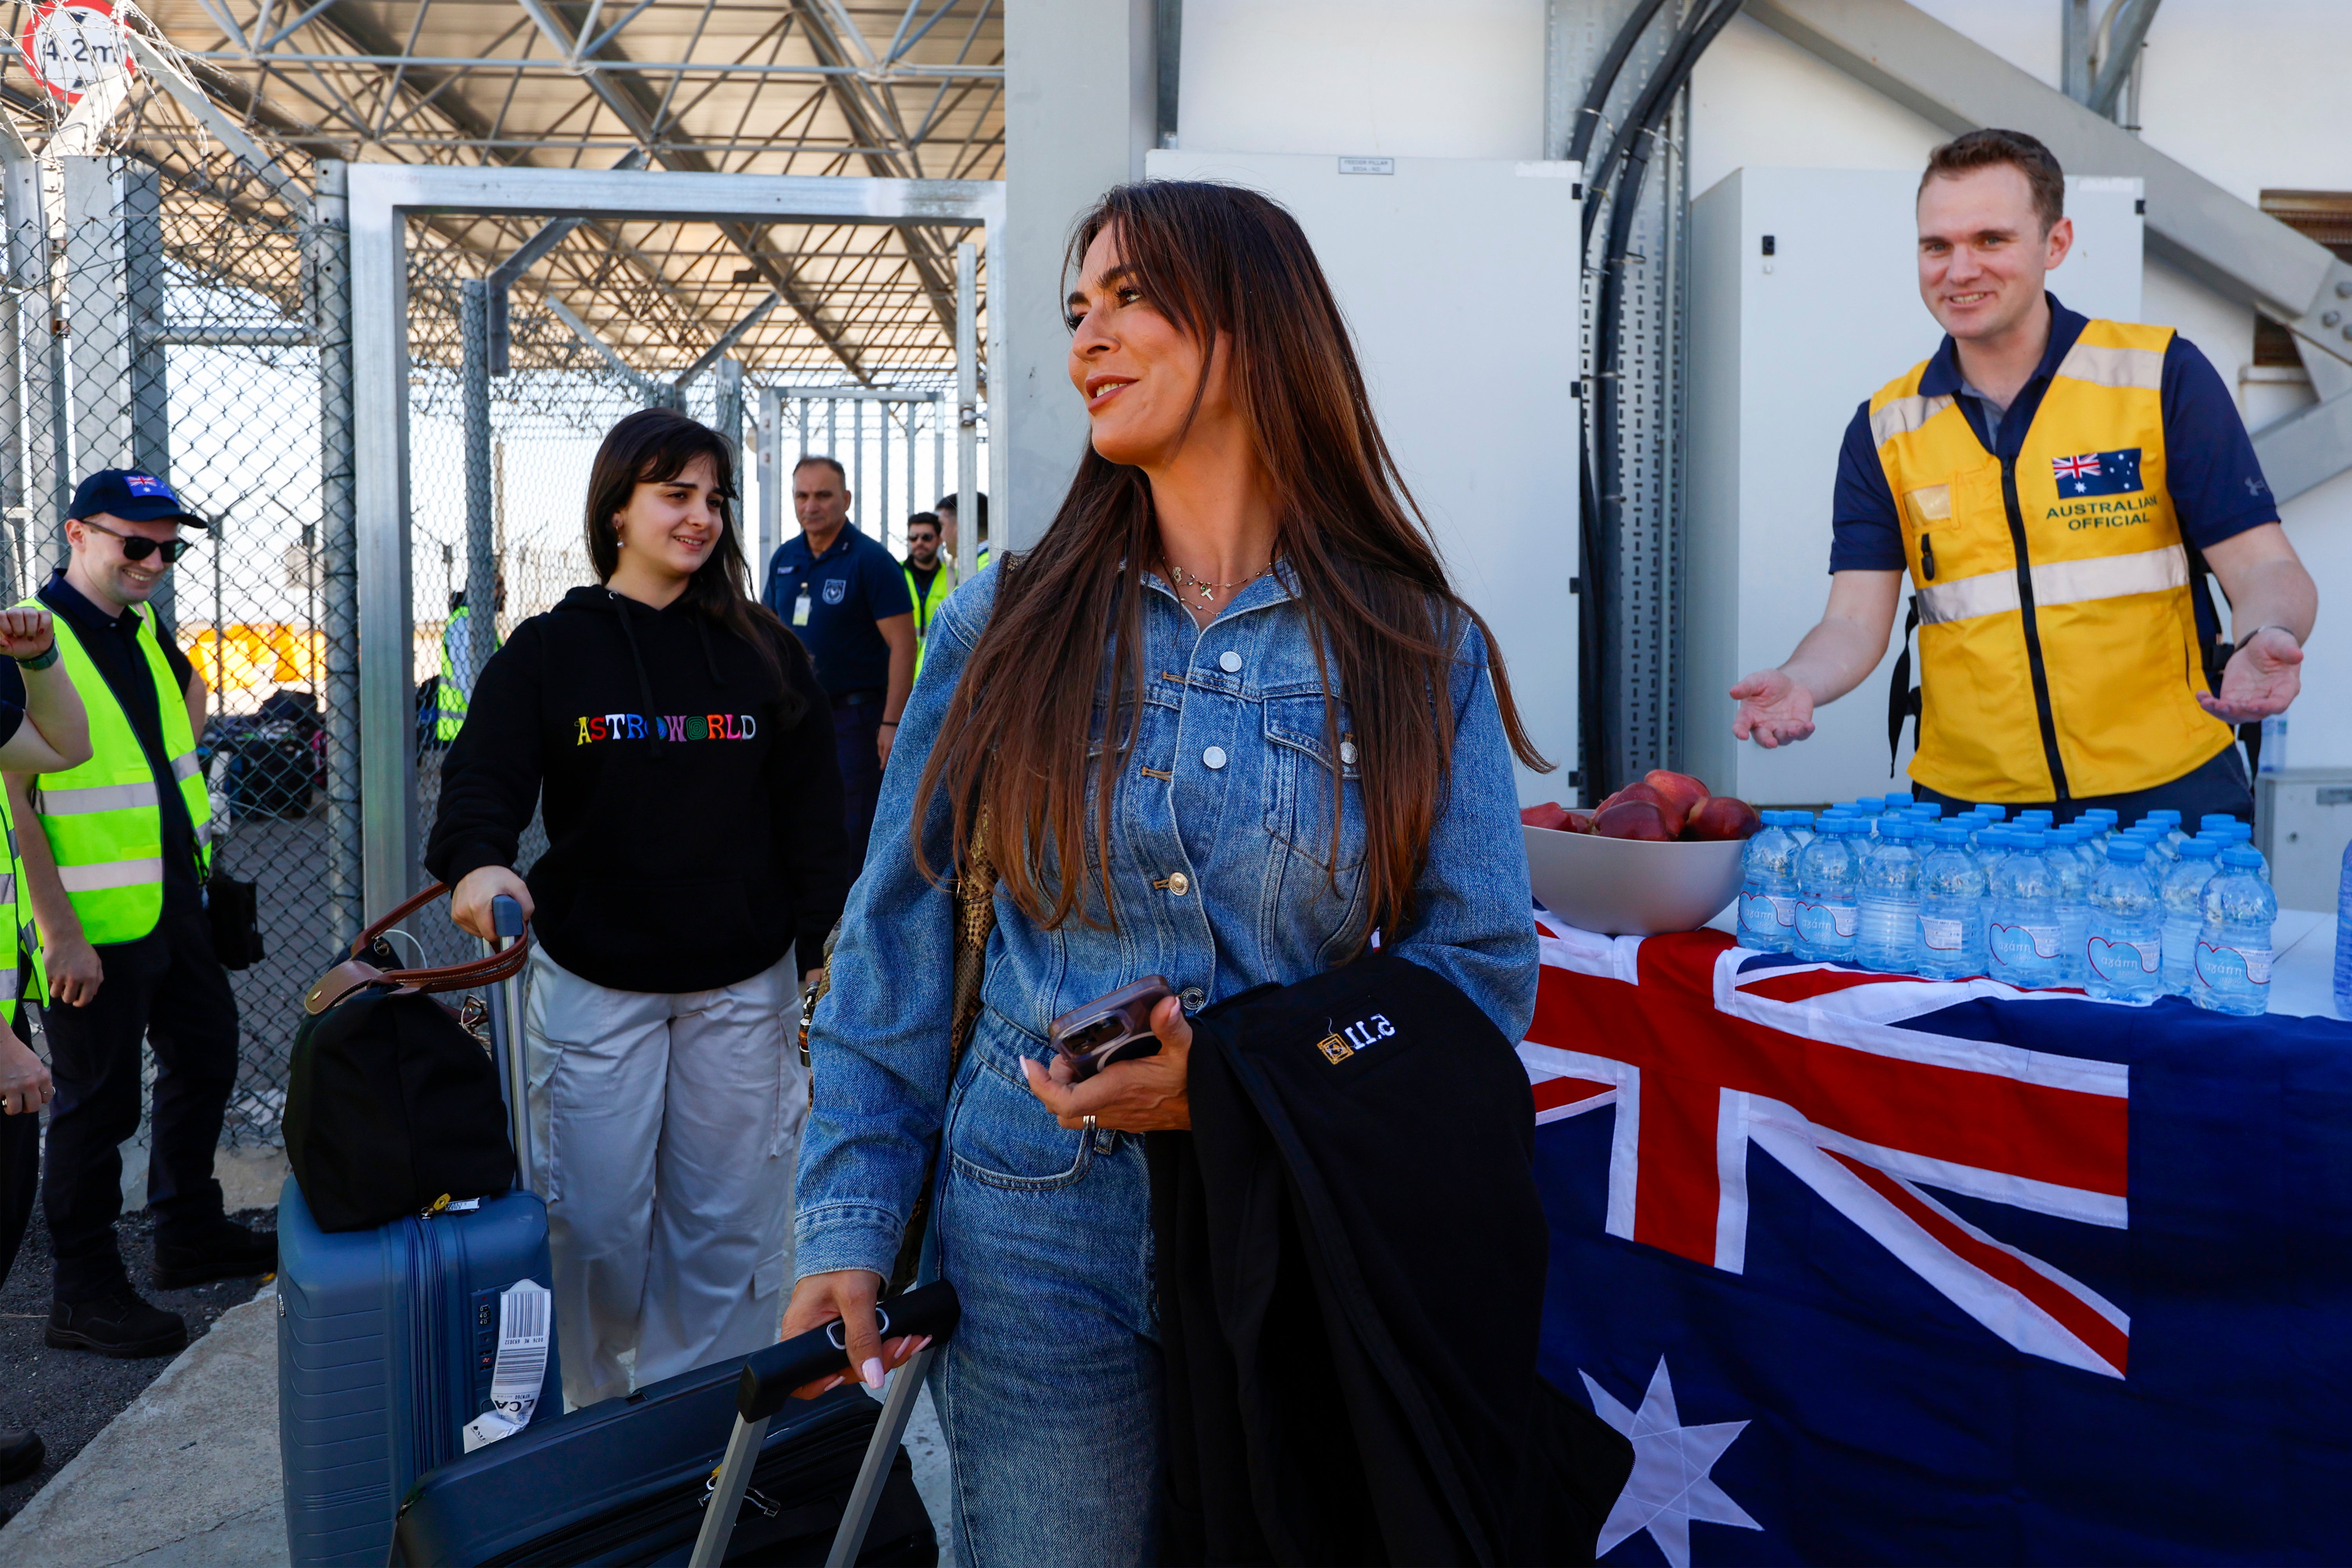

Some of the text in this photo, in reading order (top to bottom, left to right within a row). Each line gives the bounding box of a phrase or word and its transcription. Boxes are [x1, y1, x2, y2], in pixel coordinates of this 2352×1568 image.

[43, 38, 118, 63] 4.2m
[2047, 495, 2157, 519] AUSTRALIAN
[2068, 512, 2151, 531] OFFICIAL
[494, 1399, 535, 1412] LCA
